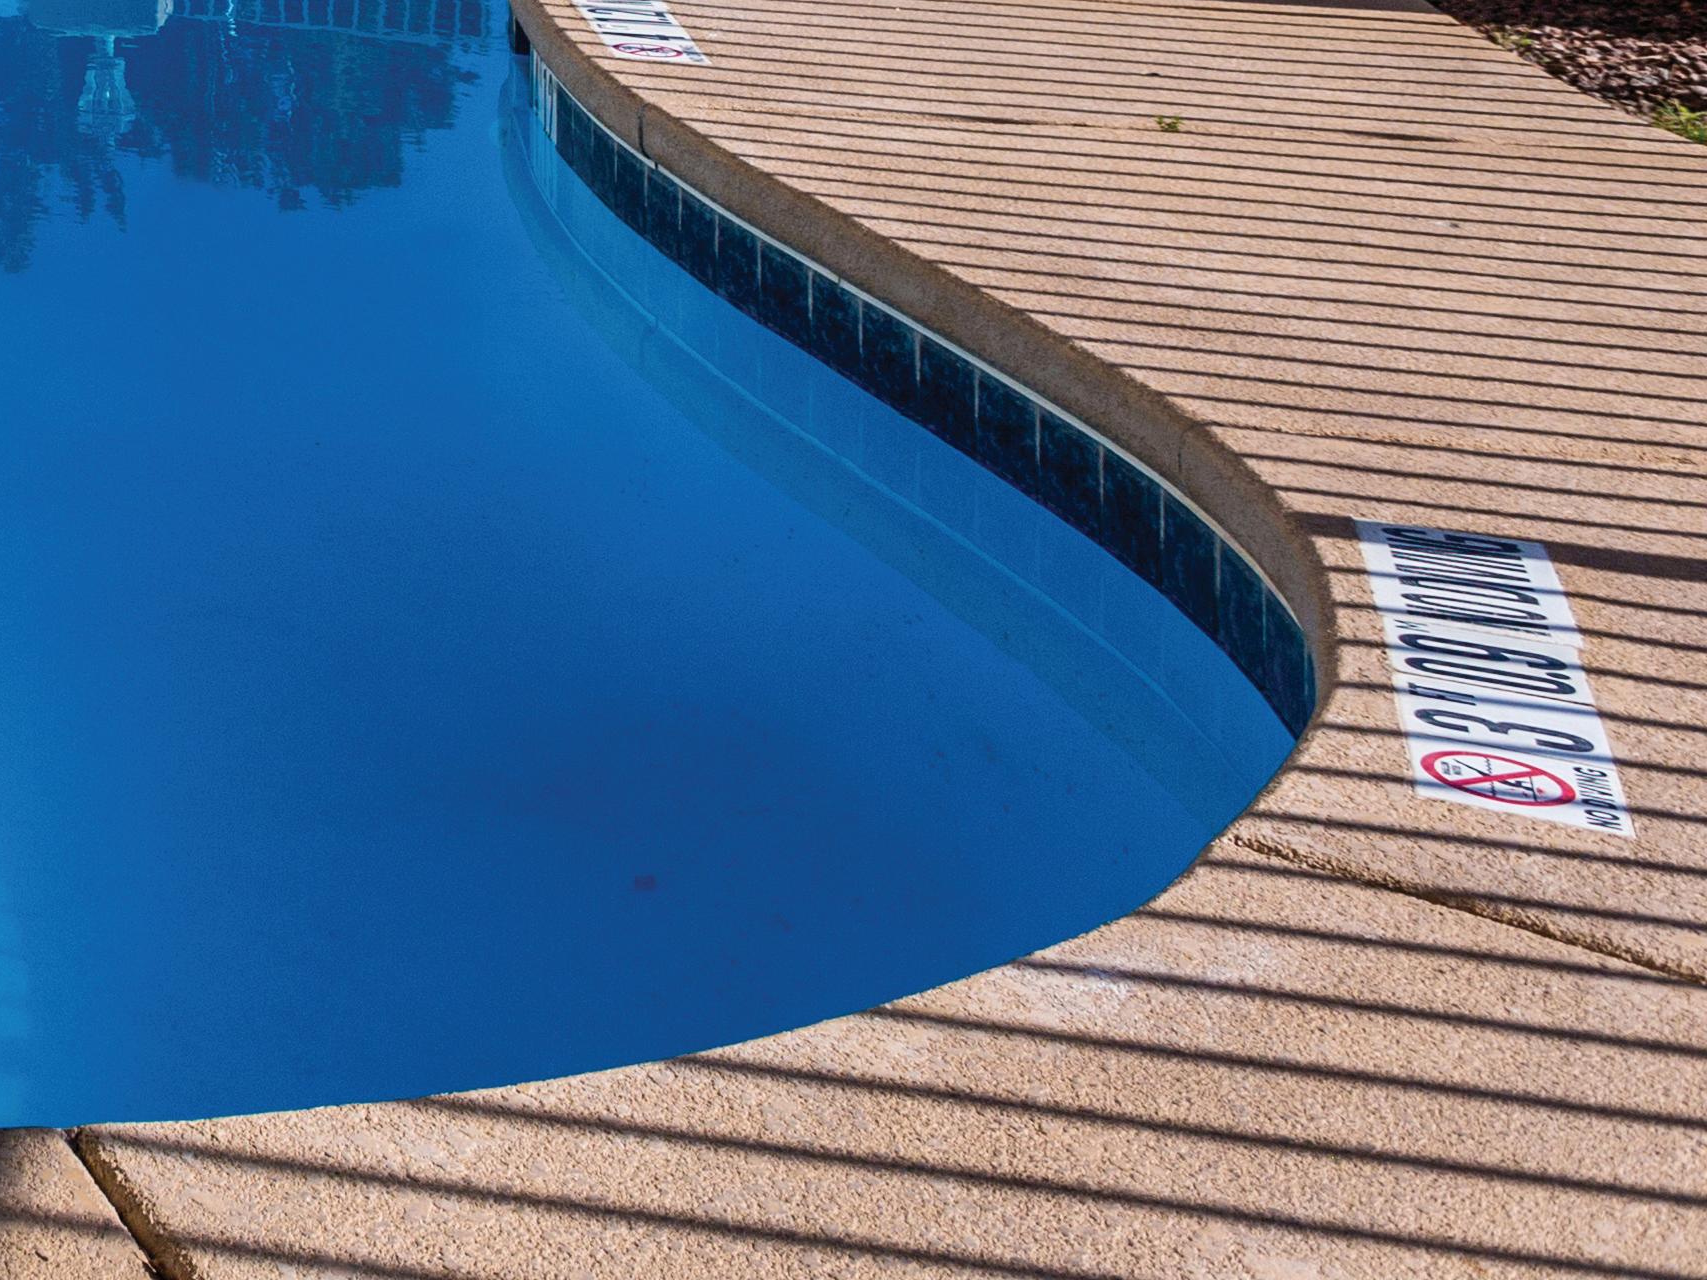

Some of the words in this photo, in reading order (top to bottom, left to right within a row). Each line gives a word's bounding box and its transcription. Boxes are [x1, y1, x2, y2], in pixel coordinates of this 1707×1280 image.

[1382, 527, 1540, 606] DIVING
[1401, 593, 1553, 637] NO
[1398, 633, 1577, 695] 0.9
[1407, 682, 1477, 706] FT
[1414, 708, 1594, 753] 3
[1572, 767, 1618, 810] DIVING
[1583, 809, 1623, 831] NO
